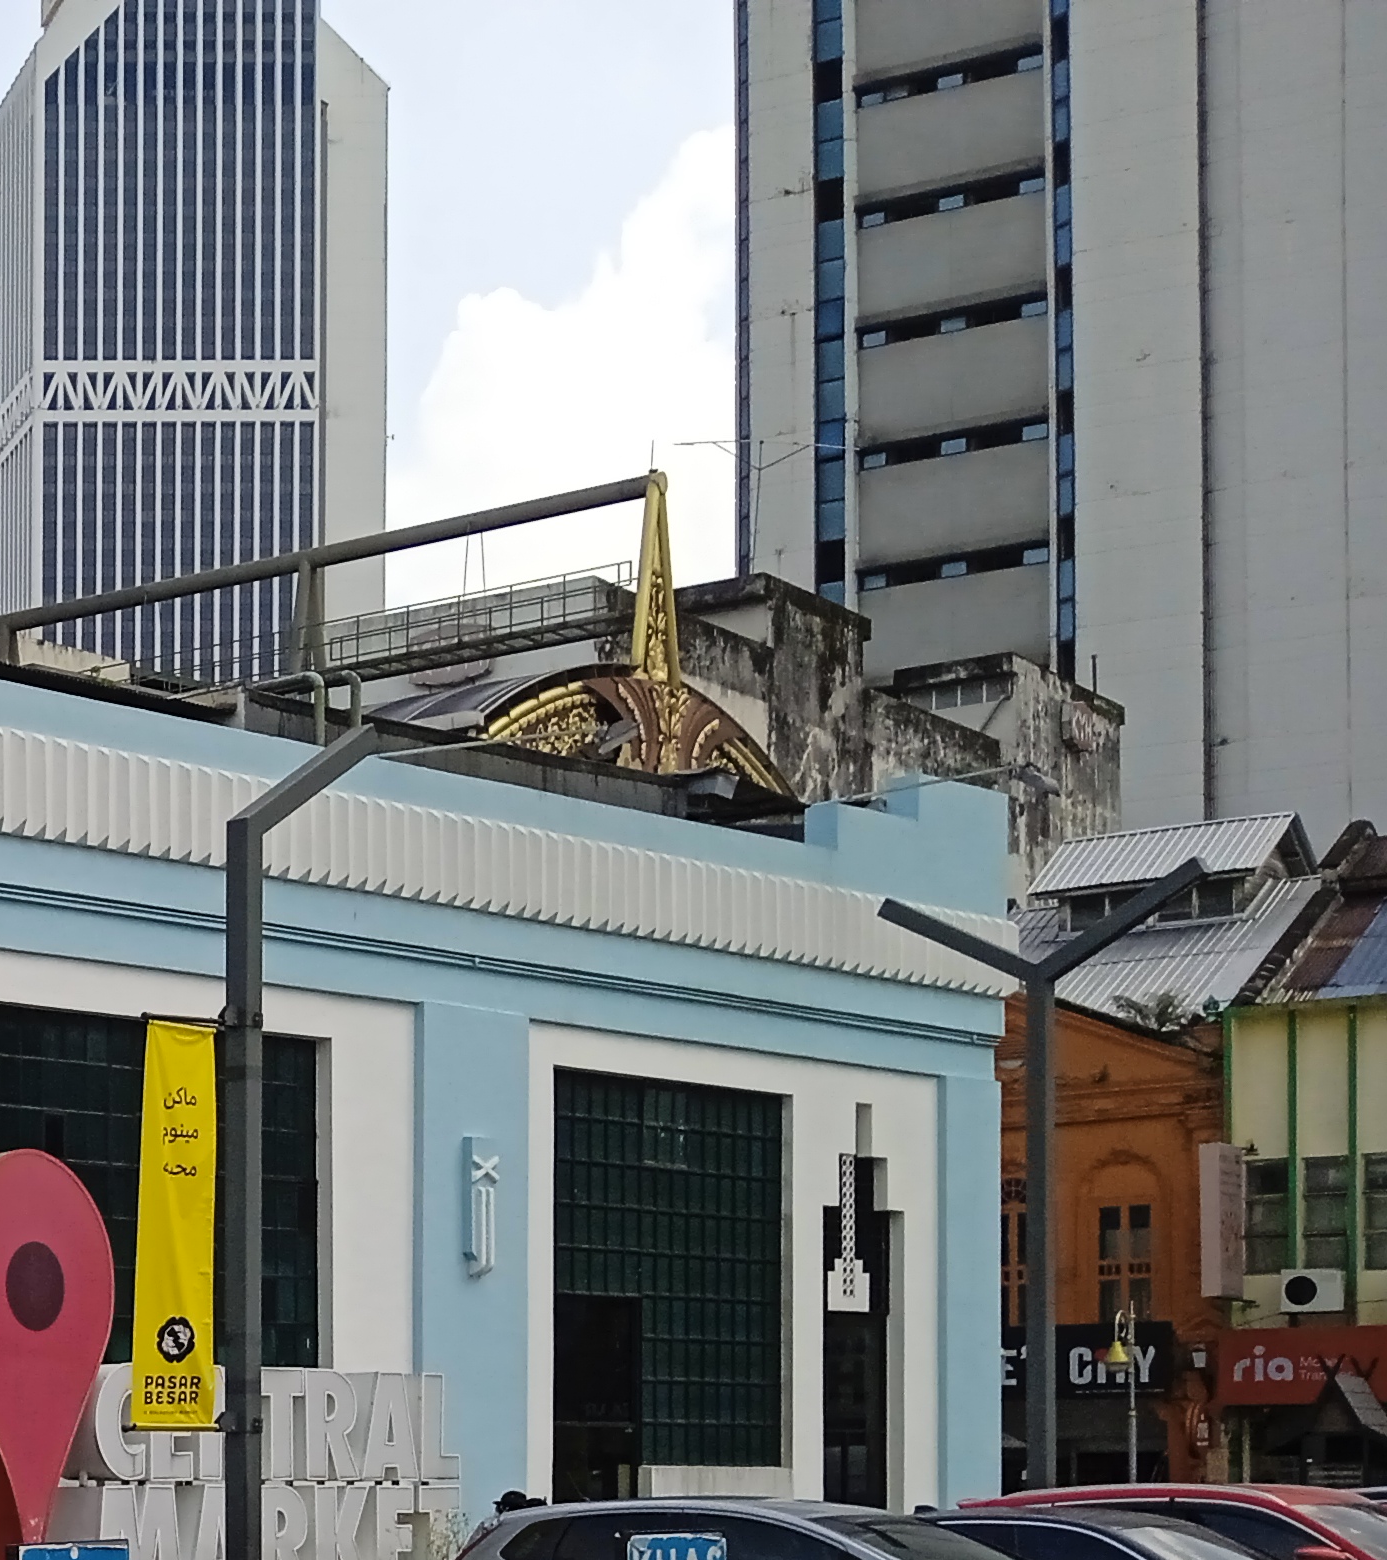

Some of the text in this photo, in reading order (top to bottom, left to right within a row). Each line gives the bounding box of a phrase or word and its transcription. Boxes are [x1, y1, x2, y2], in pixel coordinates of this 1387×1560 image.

[1233, 1345, 1294, 1381] ria
[144, 1375, 201, 1389] PASAR
[144, 1391, 199, 1405] BESAR
[96, 1364, 460, 1481] CTRAL
